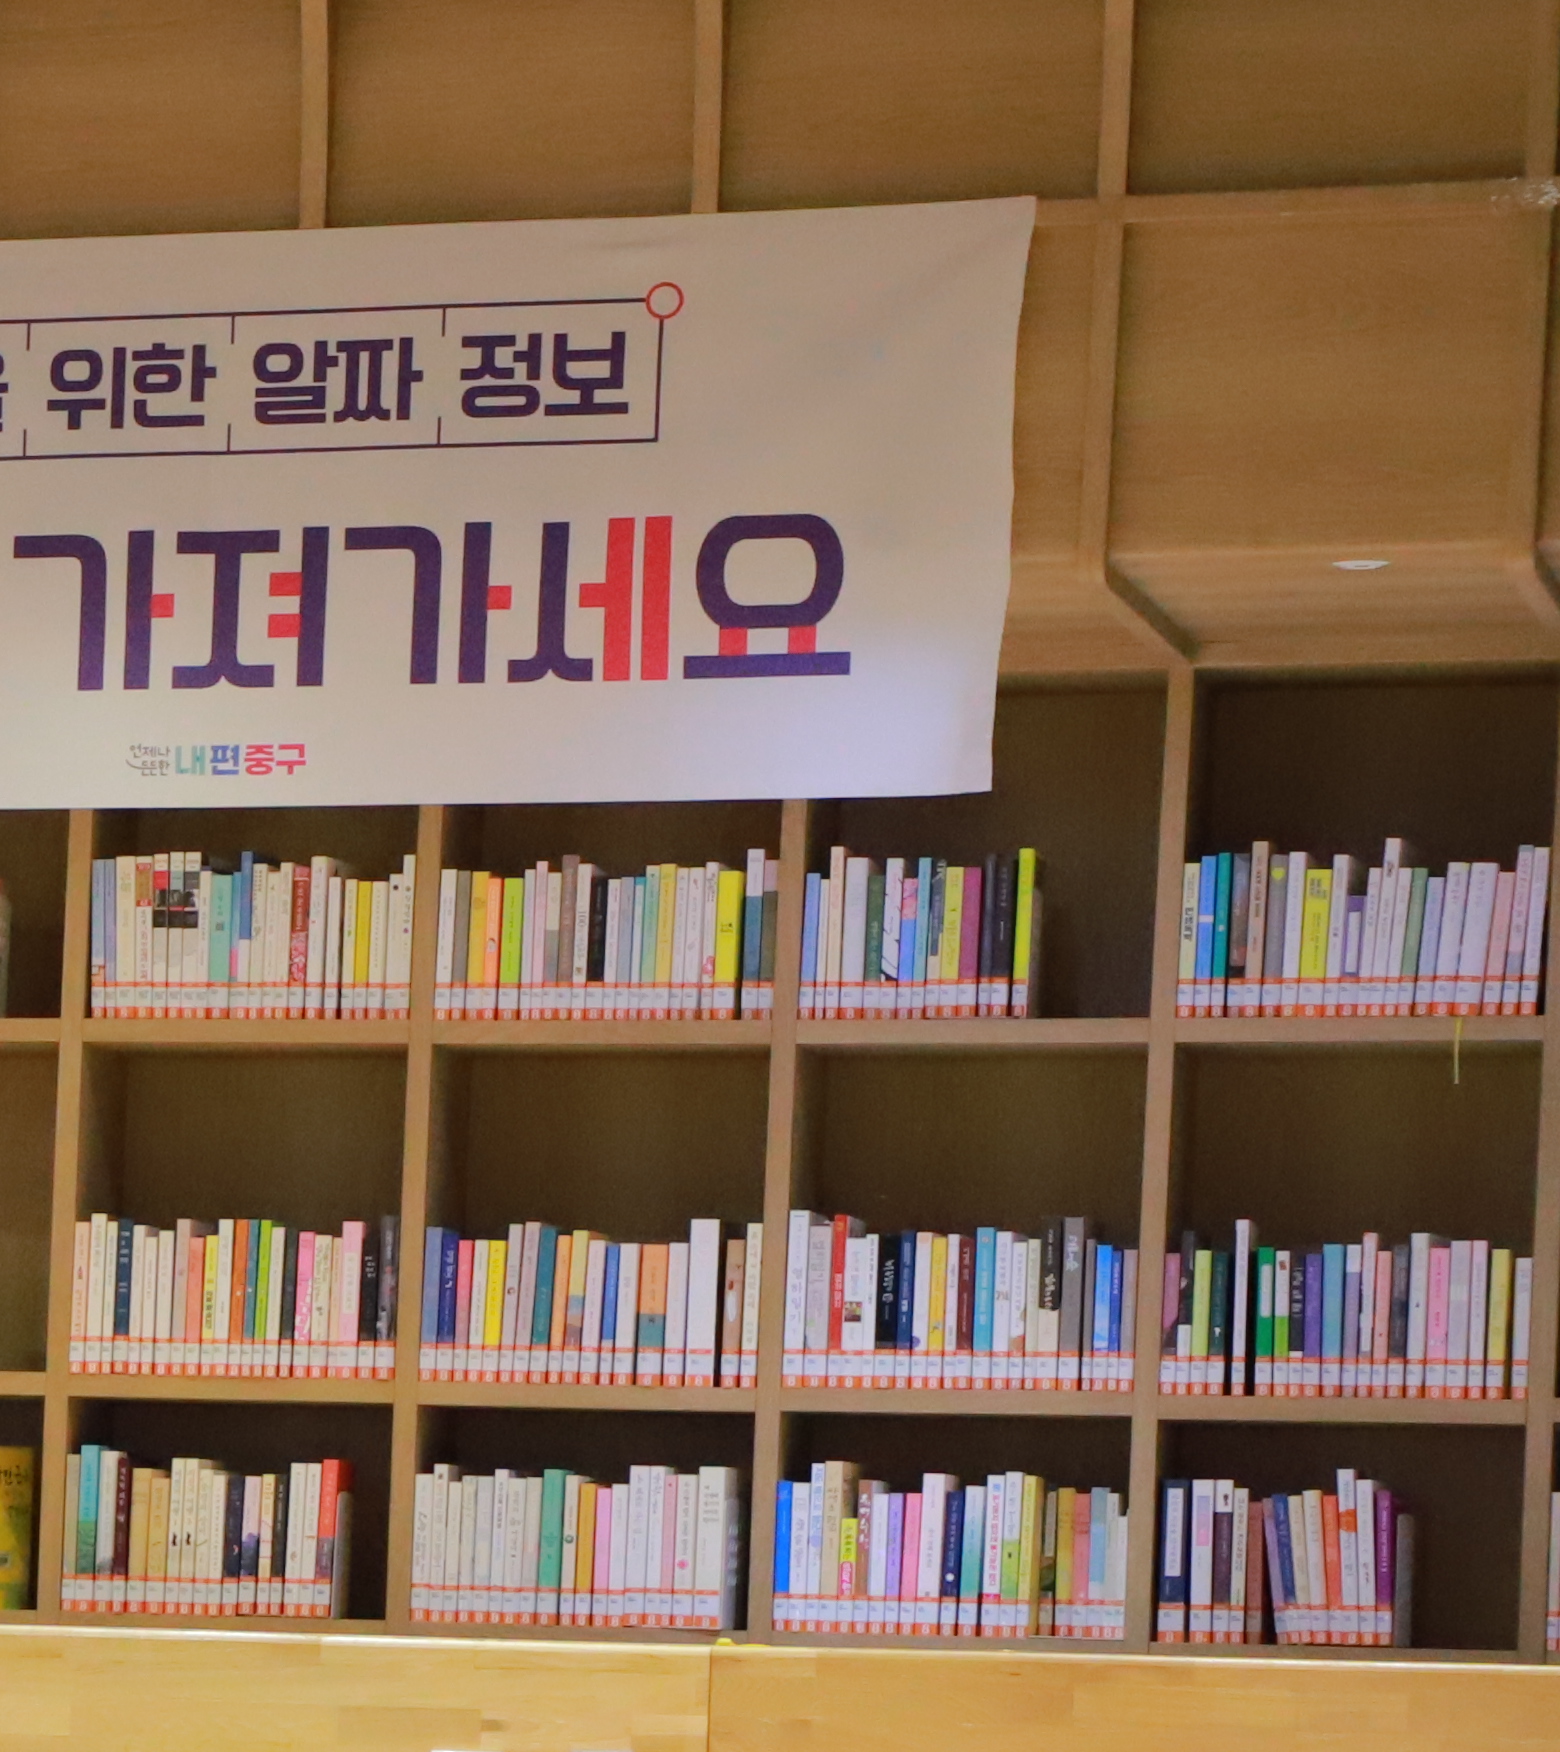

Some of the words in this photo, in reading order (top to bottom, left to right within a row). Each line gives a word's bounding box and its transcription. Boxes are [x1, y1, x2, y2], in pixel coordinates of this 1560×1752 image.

[47, 343, 218, 431] 위한
[252, 337, 424, 426] 알짜
[458, 332, 630, 420] 정보
[12, 513, 853, 691] 가져가세요
